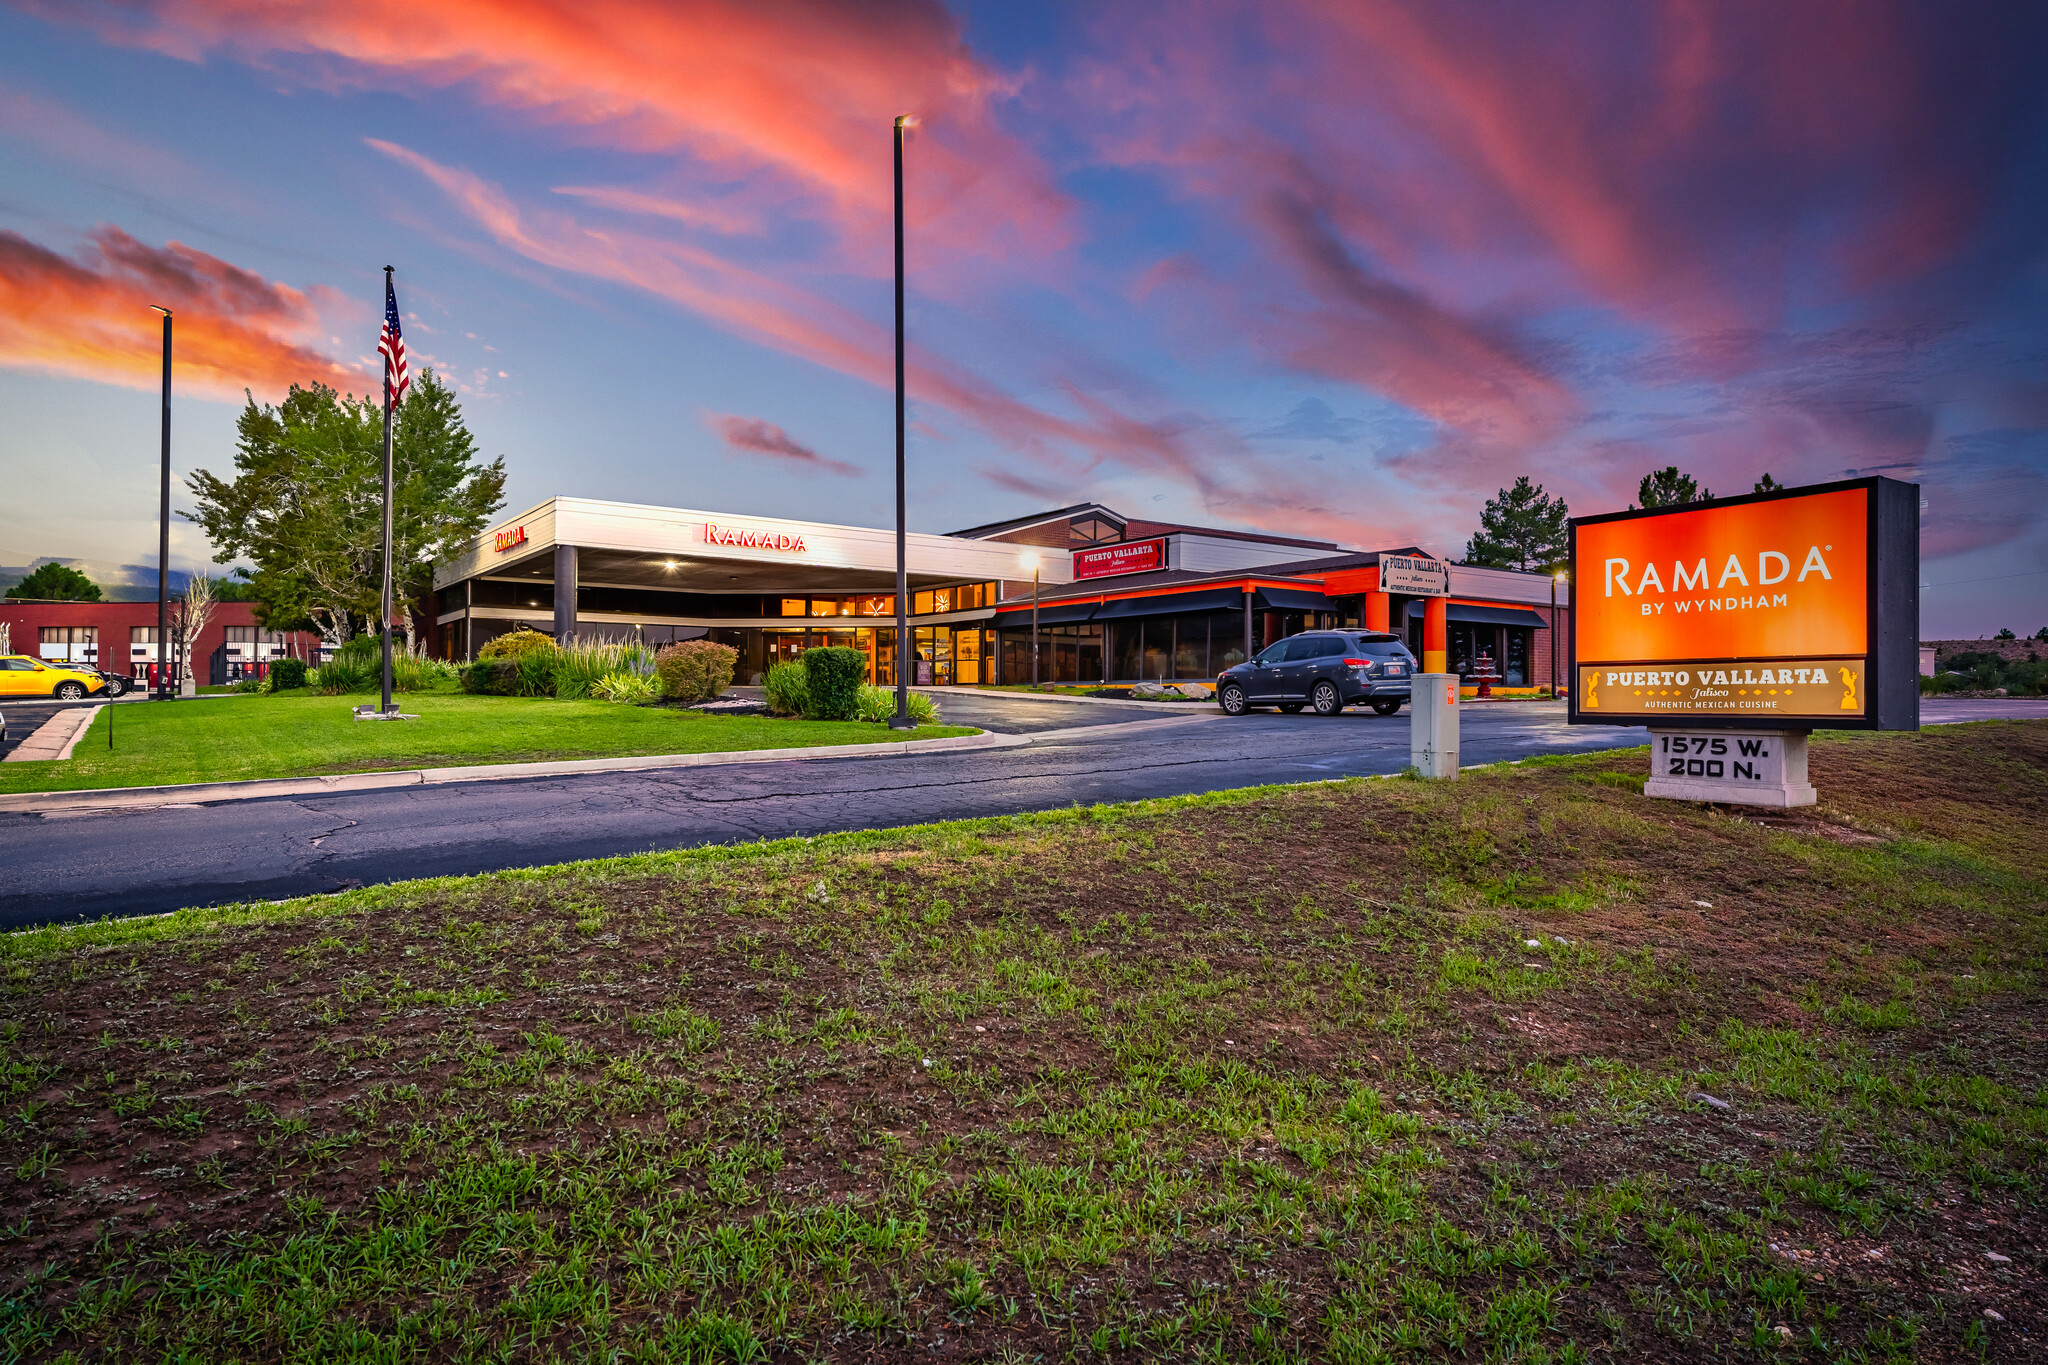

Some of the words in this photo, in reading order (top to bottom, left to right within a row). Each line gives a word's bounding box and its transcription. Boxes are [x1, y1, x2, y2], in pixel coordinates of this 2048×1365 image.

[494, 526, 524, 552] RAMADA
[705, 521, 808, 552] RAMADA
[1084, 551, 1112, 562] PUERTO
[1113, 545, 1153, 558] VALLARTA
[1390, 557, 1412, 570] PUERTO
[1413, 560, 1442, 573] VALLARTA
[1605, 545, 1832, 597] RAMADA
[1641, 602, 1665, 615] BY
[1674, 593, 1787, 613] WYNDHAM
[1606, 671, 1690, 686] PUERTO
[1697, 668, 1829, 686] VALLARTA
[1690, 687, 1729, 700] Jalisco
[1644, 701, 1692, 709] AUTHENTIC
[1695, 701, 1736, 709] MEXICAN
[1739, 701, 1778, 709] CUISINE
[1661, 736, 1728, 755] 1575
[1737, 739, 1769, 758] W.
[1669, 758, 1724, 777] 200
[1733, 761, 1761, 780] N.
